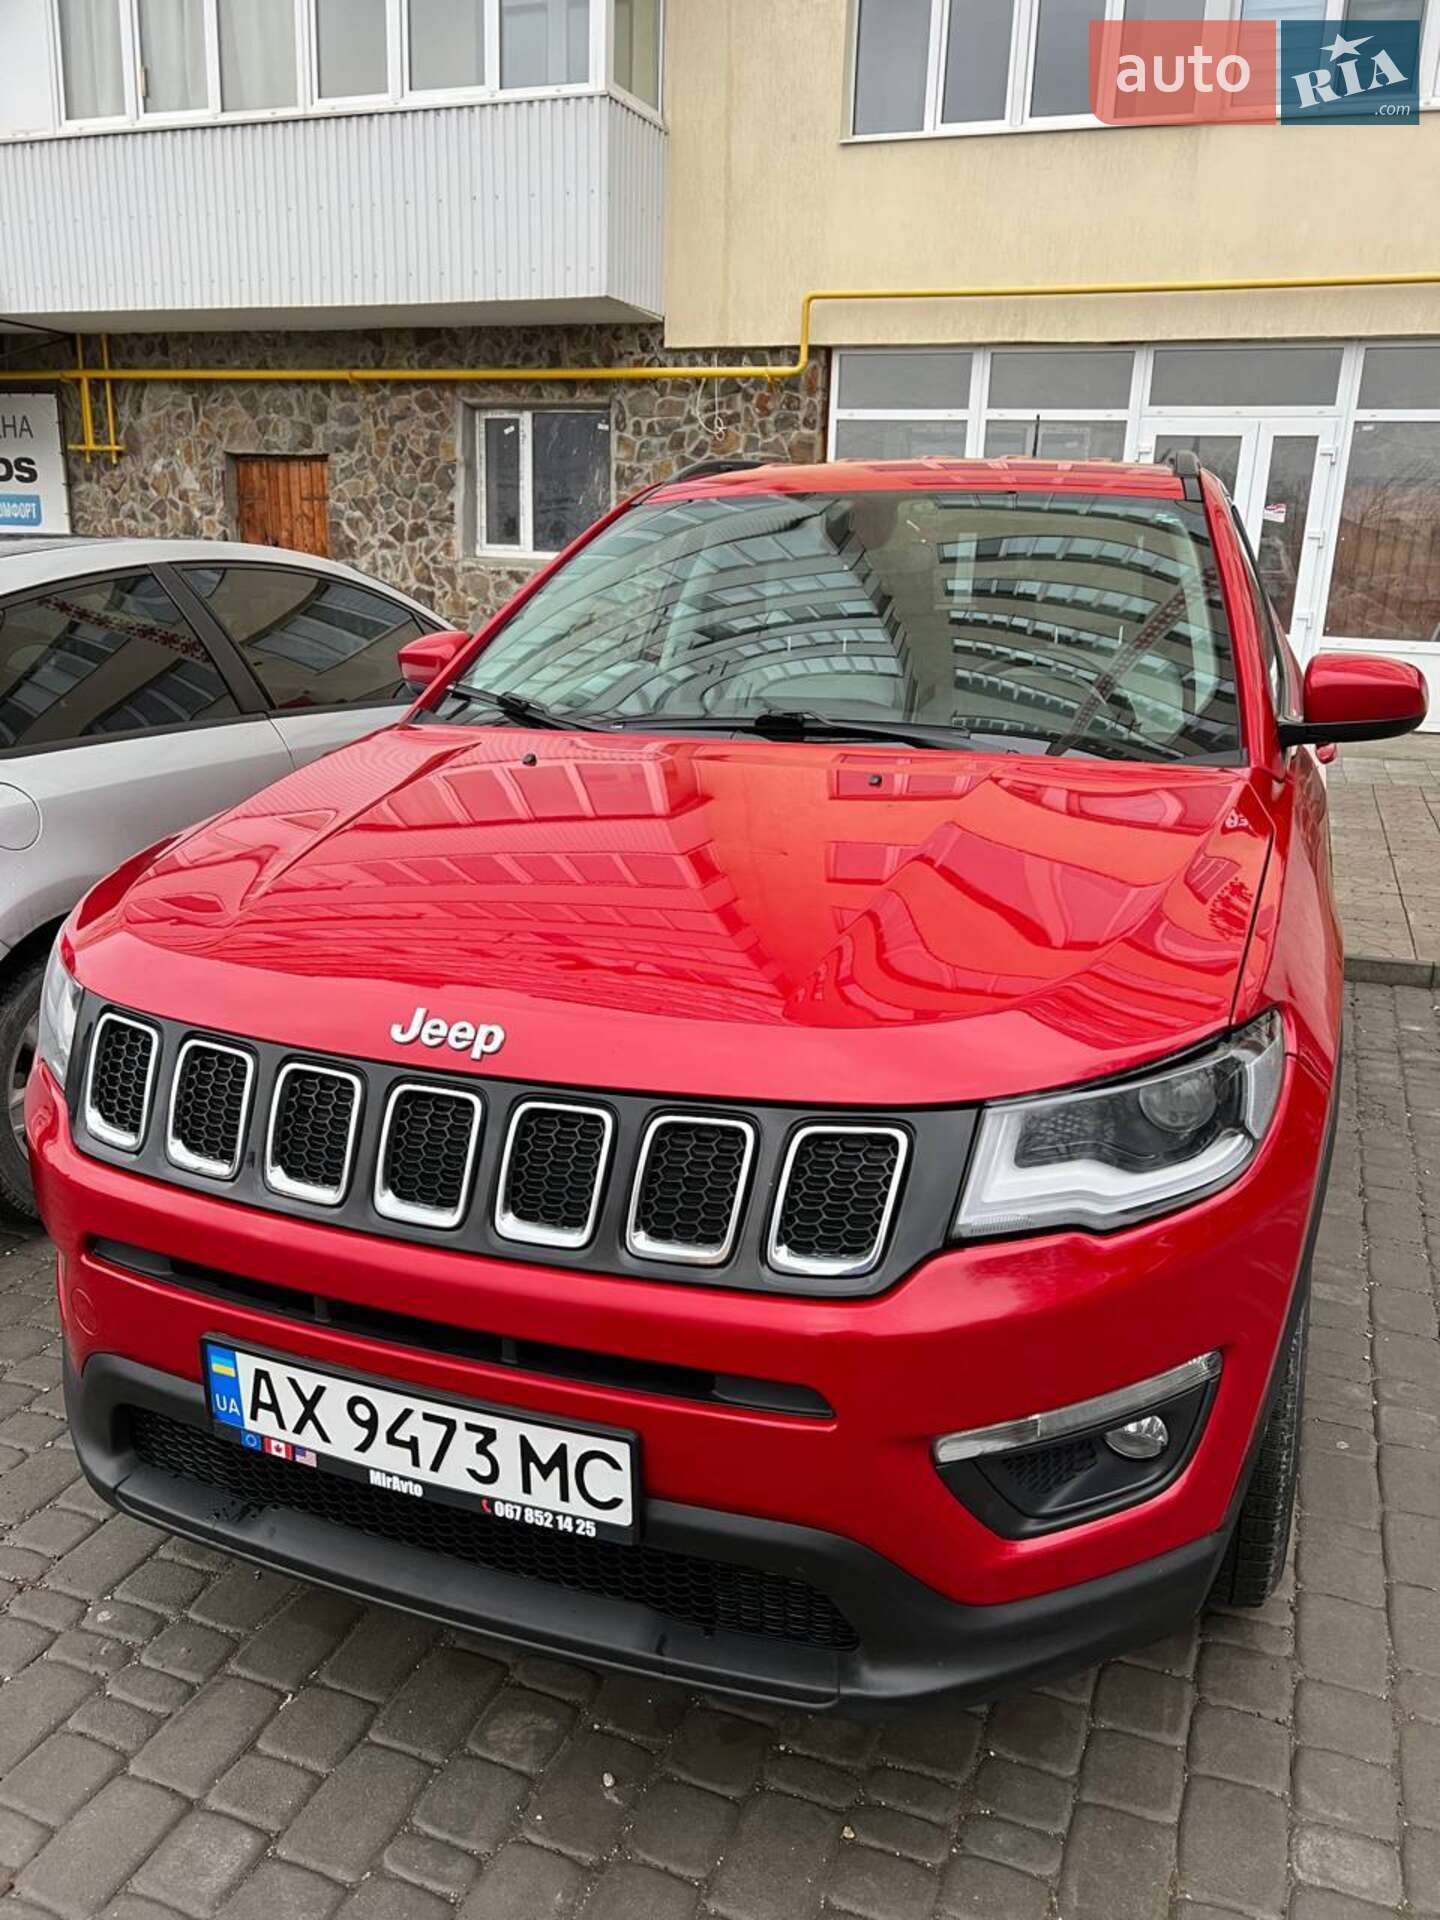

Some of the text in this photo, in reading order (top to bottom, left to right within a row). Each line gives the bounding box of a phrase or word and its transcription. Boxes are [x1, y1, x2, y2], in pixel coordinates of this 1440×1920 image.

[0, 414, 34, 439] НА
[390, 1006, 506, 1061] Jeep
[215, 1393, 241, 1417] UA
[249, 1367, 624, 1512] AX 9473 MC
[523, 1507, 553, 1529] 852
[555, 1514, 574, 1533] 14
[575, 1518, 598, 1538] 25
